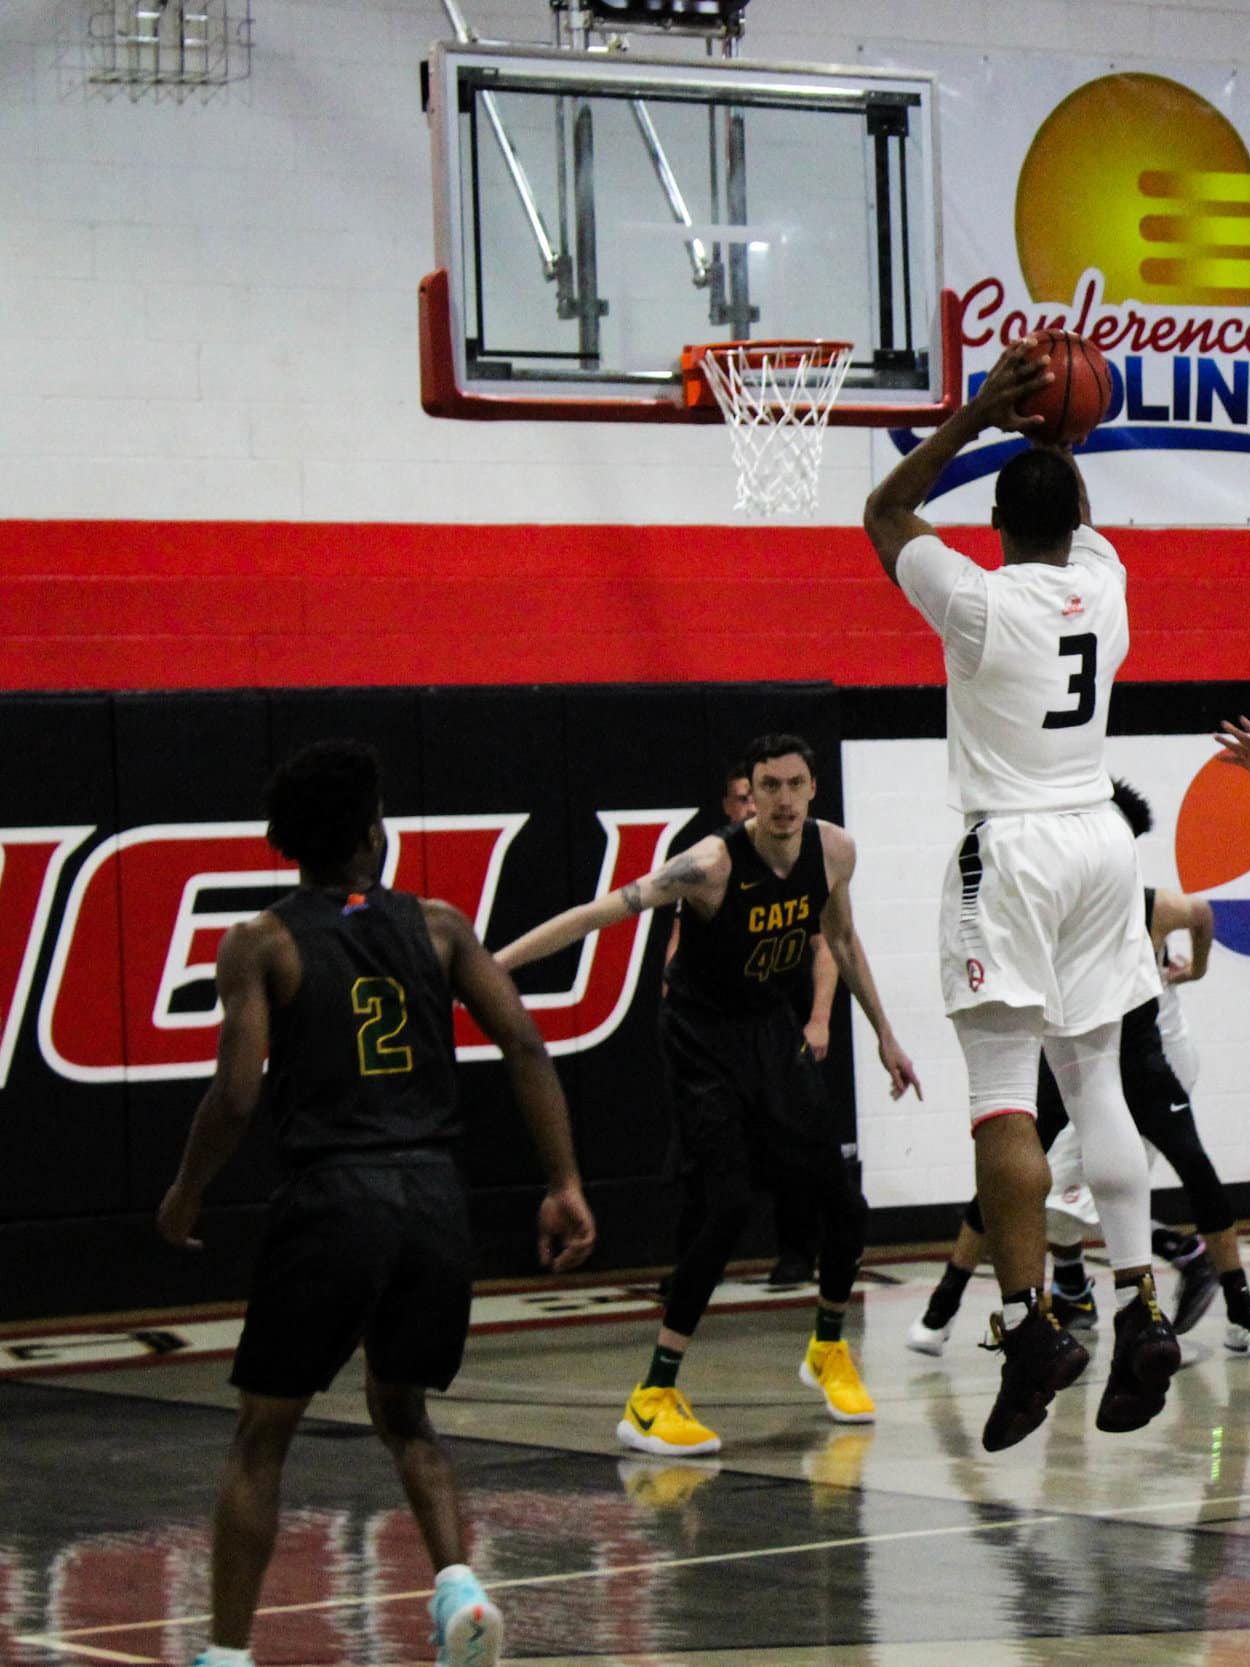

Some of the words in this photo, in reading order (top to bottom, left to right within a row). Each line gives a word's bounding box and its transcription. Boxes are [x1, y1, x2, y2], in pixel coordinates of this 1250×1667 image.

[1042, 632, 1098, 729] 3
[749, 894, 809, 934] CATS
[744, 927, 807, 983] 40
[351, 976, 413, 1077] 2
